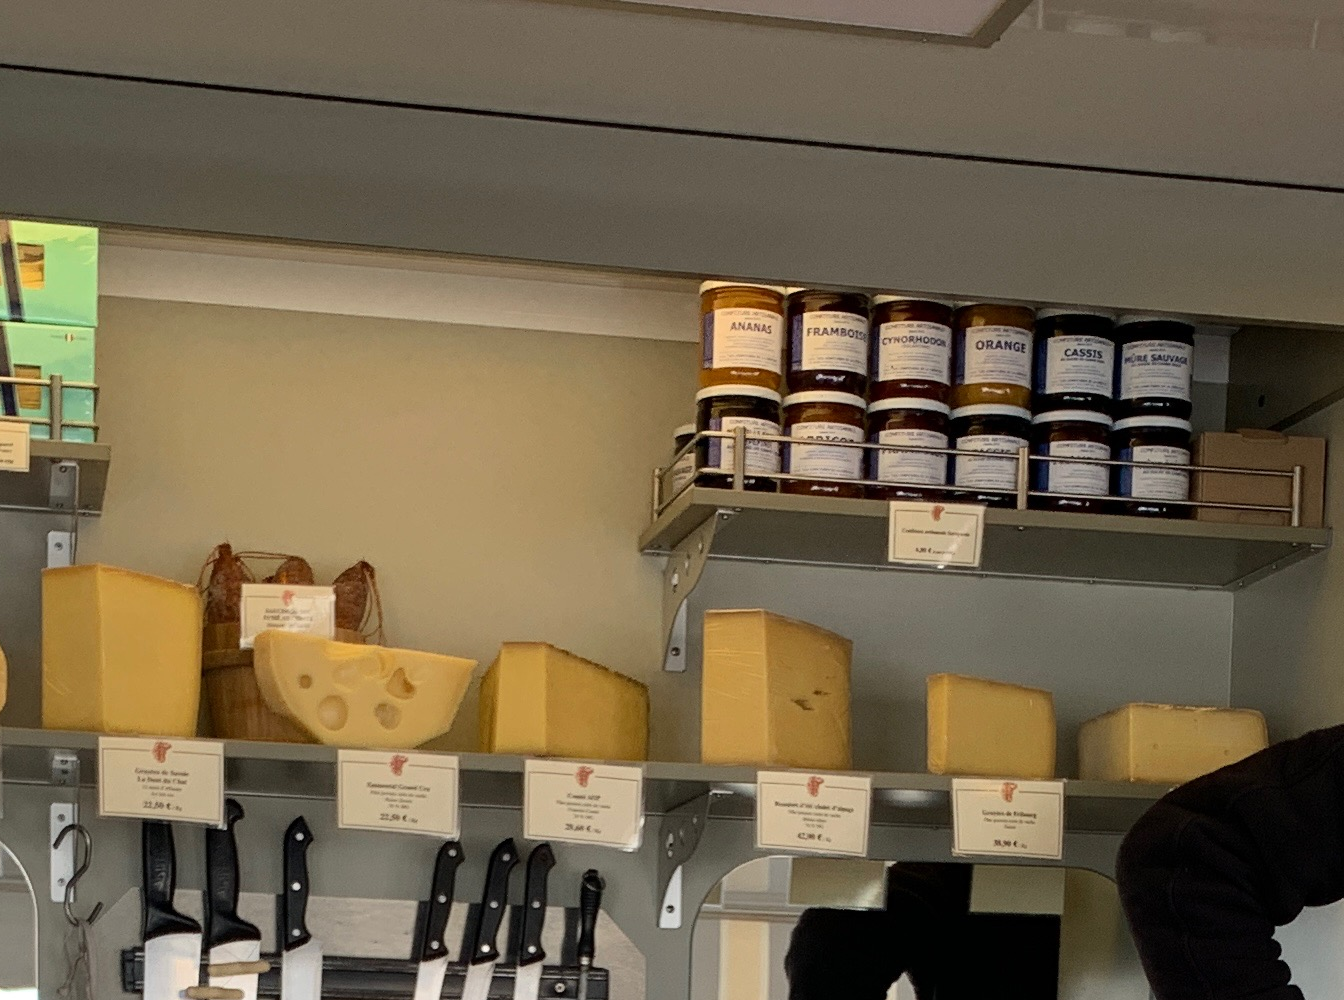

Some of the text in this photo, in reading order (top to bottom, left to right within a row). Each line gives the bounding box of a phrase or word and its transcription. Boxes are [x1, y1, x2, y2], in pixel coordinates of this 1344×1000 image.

[730, 322, 772, 334] ANANAS
[976, 340, 1026, 353] ORANGE
[1064, 348, 1103, 359] CASSIS
